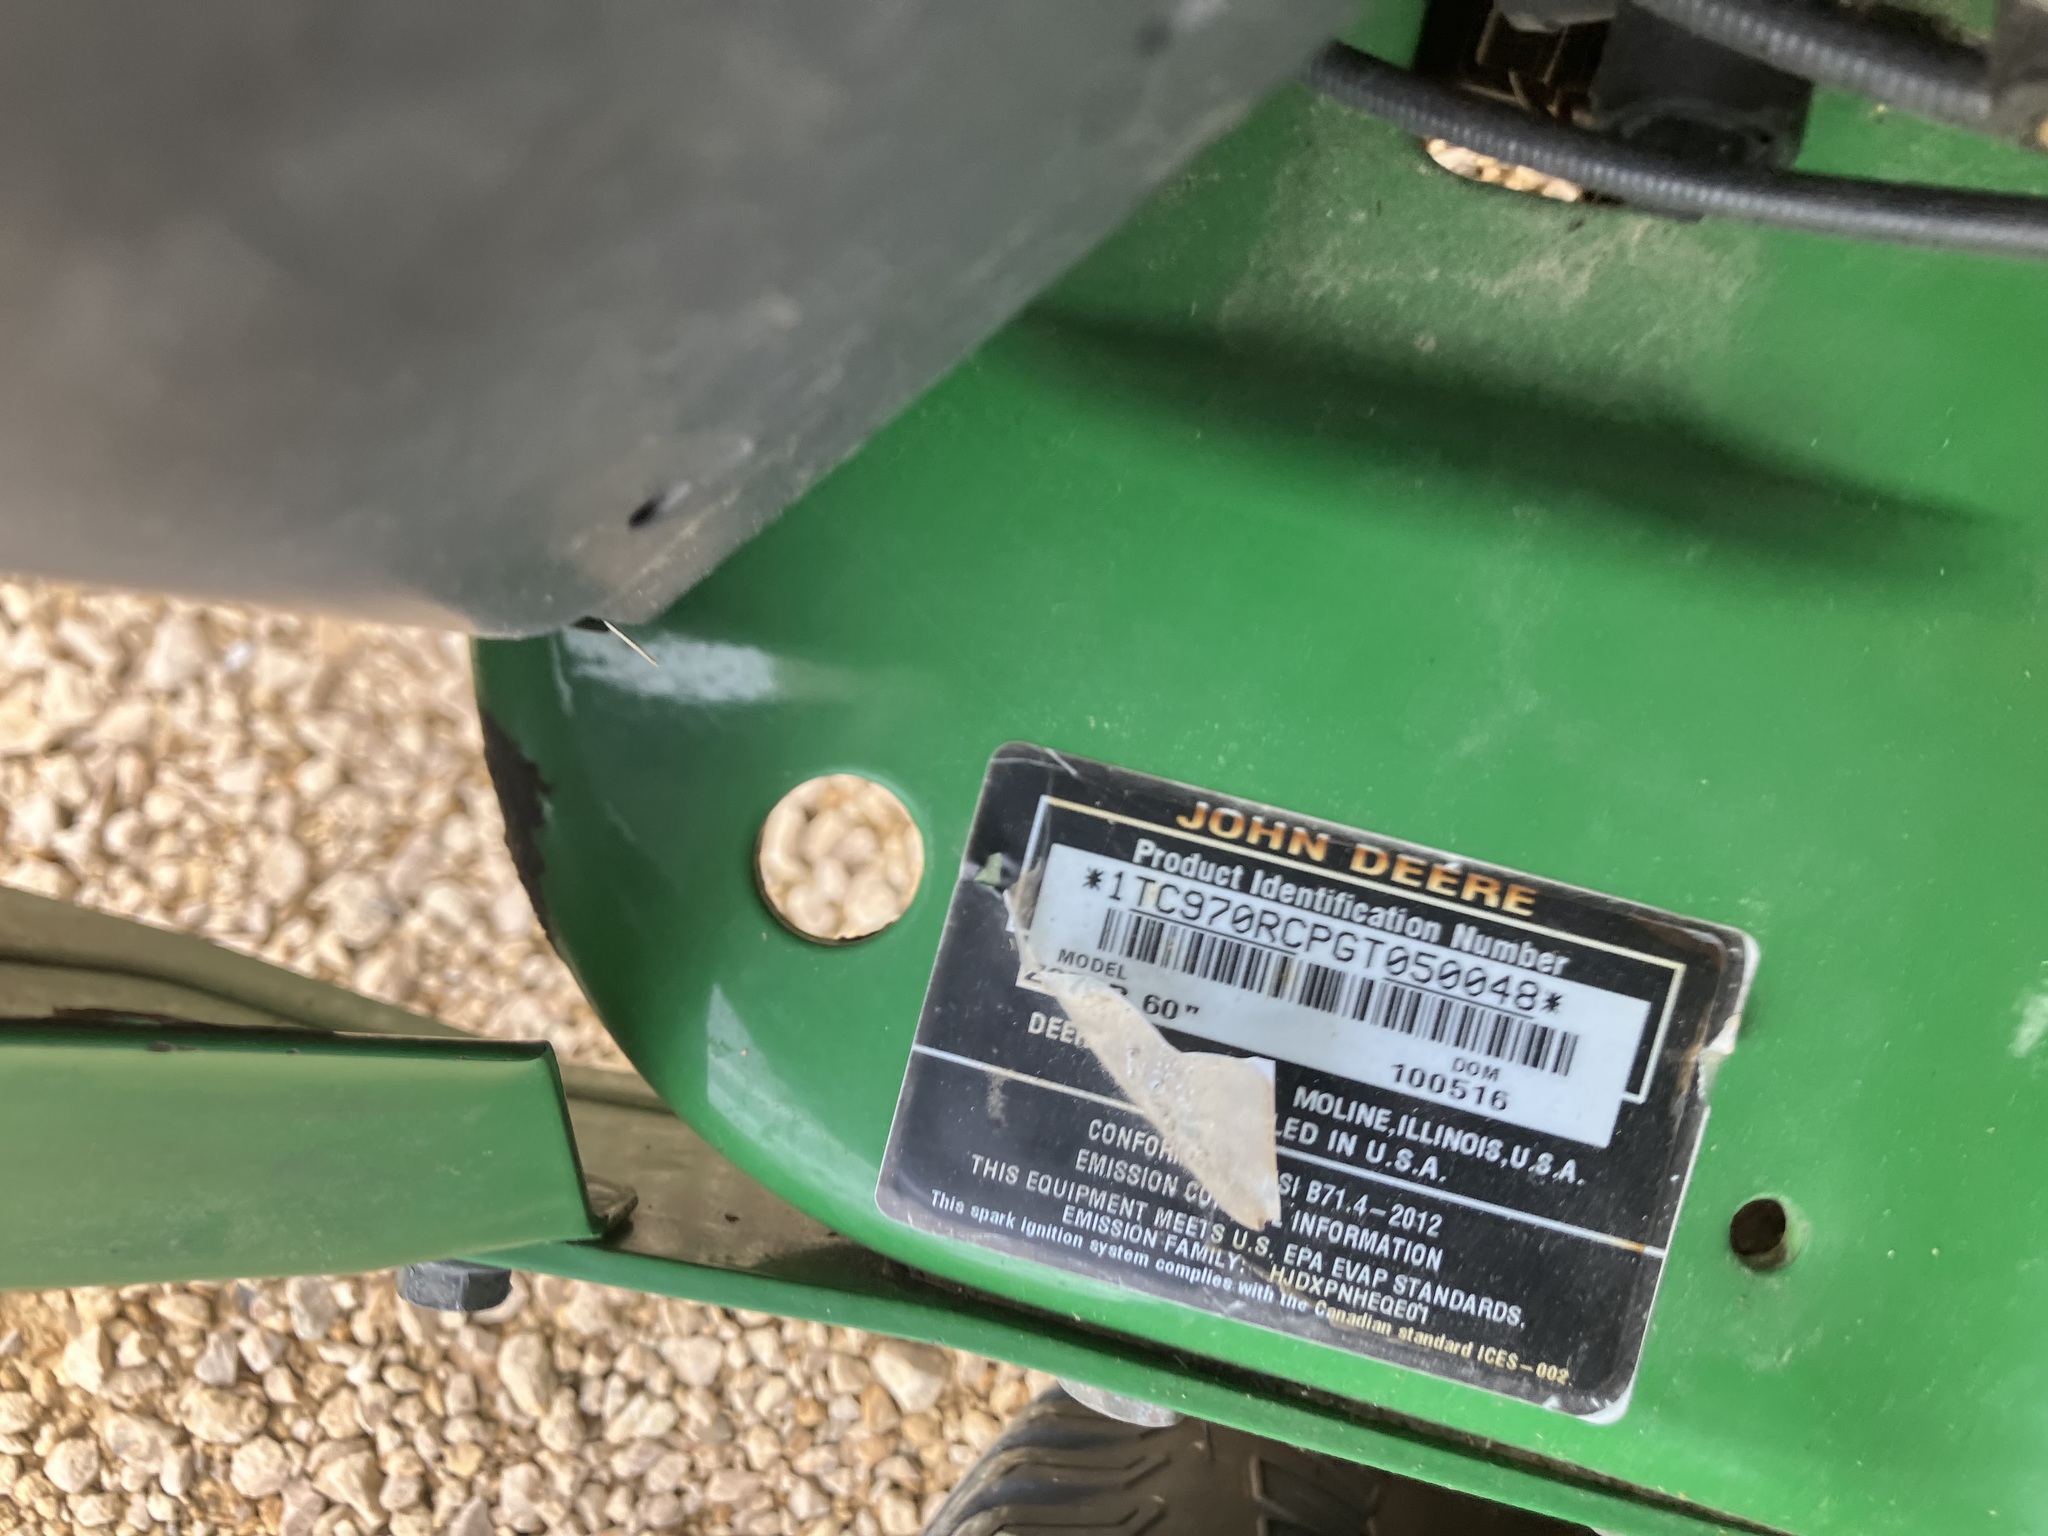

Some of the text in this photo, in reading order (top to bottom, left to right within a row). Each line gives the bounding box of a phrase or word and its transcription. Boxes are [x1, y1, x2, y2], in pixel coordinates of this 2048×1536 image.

[1174, 796, 1539, 918] JOHN DEERE
[1131, 836, 1571, 978] Product Identification Number
[1057, 948, 1131, 981] MODEL
[1027, 1010, 1087, 1048] DEE
[1451, 1056, 1500, 1082] DOM
[1388, 1061, 1511, 1112] 100516
[1086, 1118, 1180, 1164] CONFOR
[1305, 1180, 1444, 1238] B71.4-2012
[1326, 1128, 1358, 1157] IN
[1365, 1139, 1450, 1183] U.S.A.
[968, 1154, 1020, 1186] THIS
[1025, 1170, 1149, 1222] EQUIPMENT
[1153, 1206, 1226, 1245] MEETS
[1230, 1228, 1277, 1259] U.S.
[1282, 1242, 1325, 1272] EPA
[1331, 1256, 1389, 1290] EVAP
[1392, 1273, 1528, 1329] STANDARDS.
[1061, 1205, 1159, 1249] EMISSION
[1163, 1234, 1248, 1274] FAMILY:
[1074, 1148, 1179, 1198] EMISSION
[1291, 1210, 1444, 1272] INFORMATION
[928, 1189, 966, 1214] This
[969, 1202, 1017, 1229] spark
[1020, 1216, 1084, 1249] ignition
[1088, 1237, 1151, 1268] system
[1154, 1256, 1233, 1292] complies
[1236, 1277, 1275, 1304] with
[1279, 1291, 1309, 1313] the
[1313, 1299, 1393, 1337] Canadian
[1397, 1324, 1473, 1358] standard
